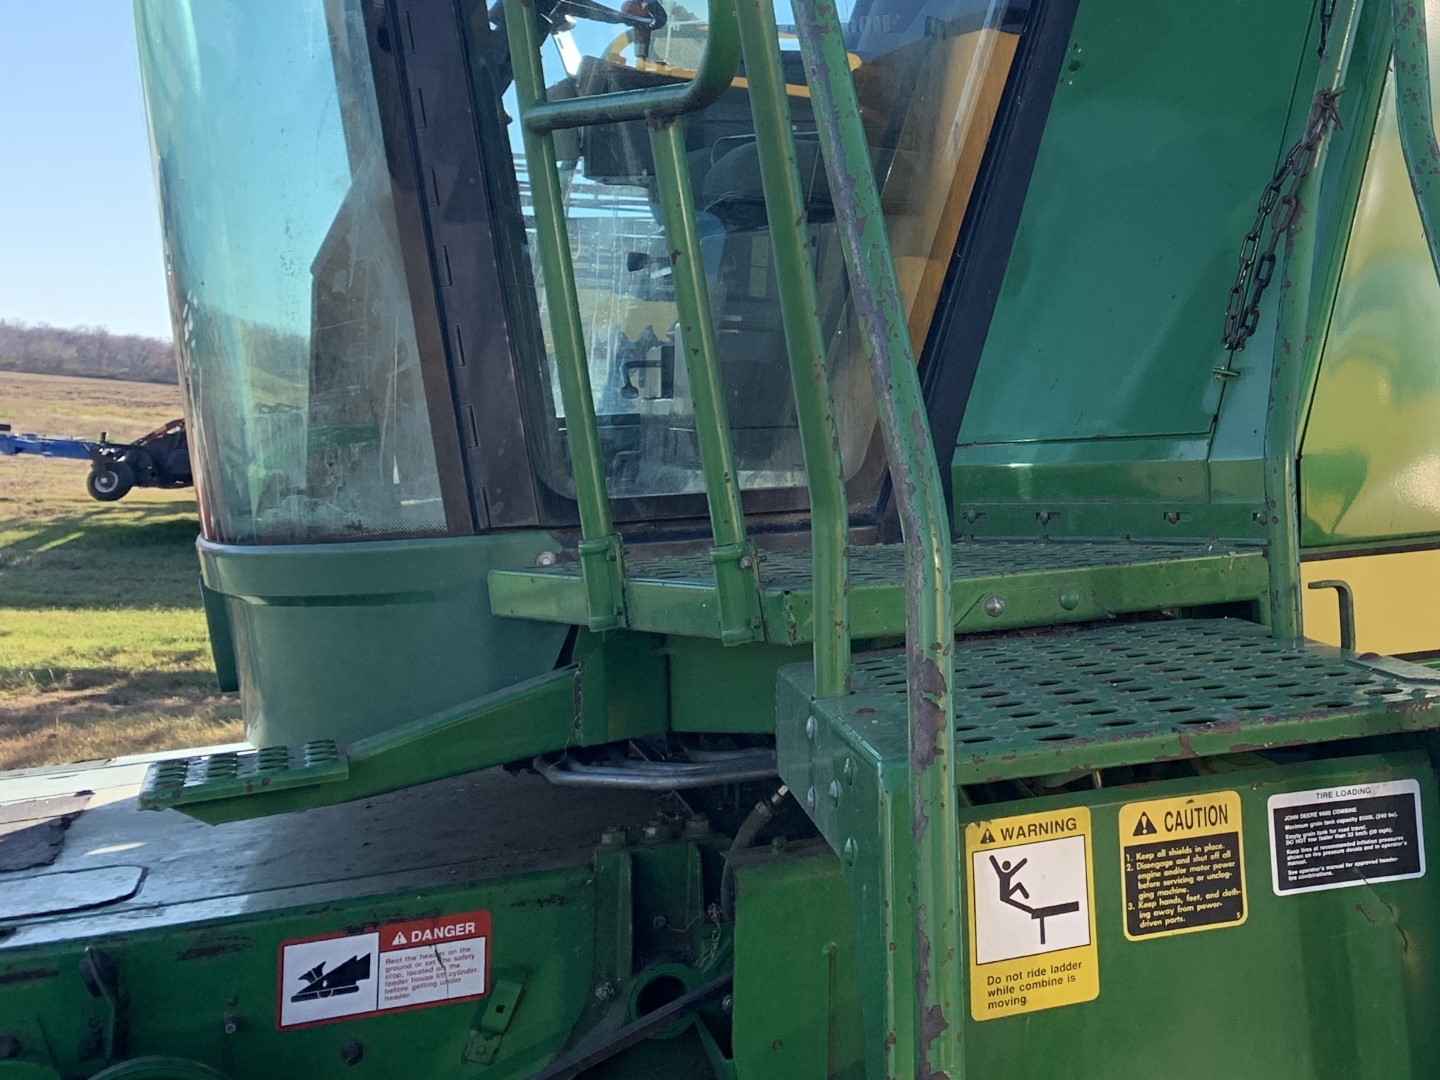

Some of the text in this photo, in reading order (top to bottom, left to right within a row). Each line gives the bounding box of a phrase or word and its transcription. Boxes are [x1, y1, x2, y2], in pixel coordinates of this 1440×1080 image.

[1316, 787, 1371, 799] TIRE LOADING
[1164, 803, 1228, 832] CAUTION
[1000, 818, 1077, 841] WARNING
[1126, 842, 1225, 862] 1. Keep all shields in place.
[1126, 850, 1231, 872] 2. Disengage and shut off all
[1137, 871, 1161, 881] engine
[1189, 864, 1210, 873] motor
[1213, 861, 1236, 871] power
[1138, 870, 1232, 890] before servicing or unclog-
[1138, 886, 1189, 901] ging machine.
[1138, 900, 1156, 909] Keep
[1159, 896, 1183, 906] hands,
[1205, 890, 1220, 900] and
[1139, 901, 1222, 919] ing away from power-
[1140, 916, 1185, 929] driven parts.
[411, 922, 475, 943] DANGER
[385, 957, 402, 965] Rest
[385, 963, 411, 973] ground
[454, 953, 475, 961] safety
[385, 978, 408, 987] feeder
[411, 974, 433, 983] house
[407, 966, 433, 976] located
[987, 961, 1082, 986] Do not ride ladder
[385, 985, 408, 994] before
[411, 981, 437, 991] getting
[987, 974, 1076, 997] while combine is
[987, 996, 1029, 1010] moving.
